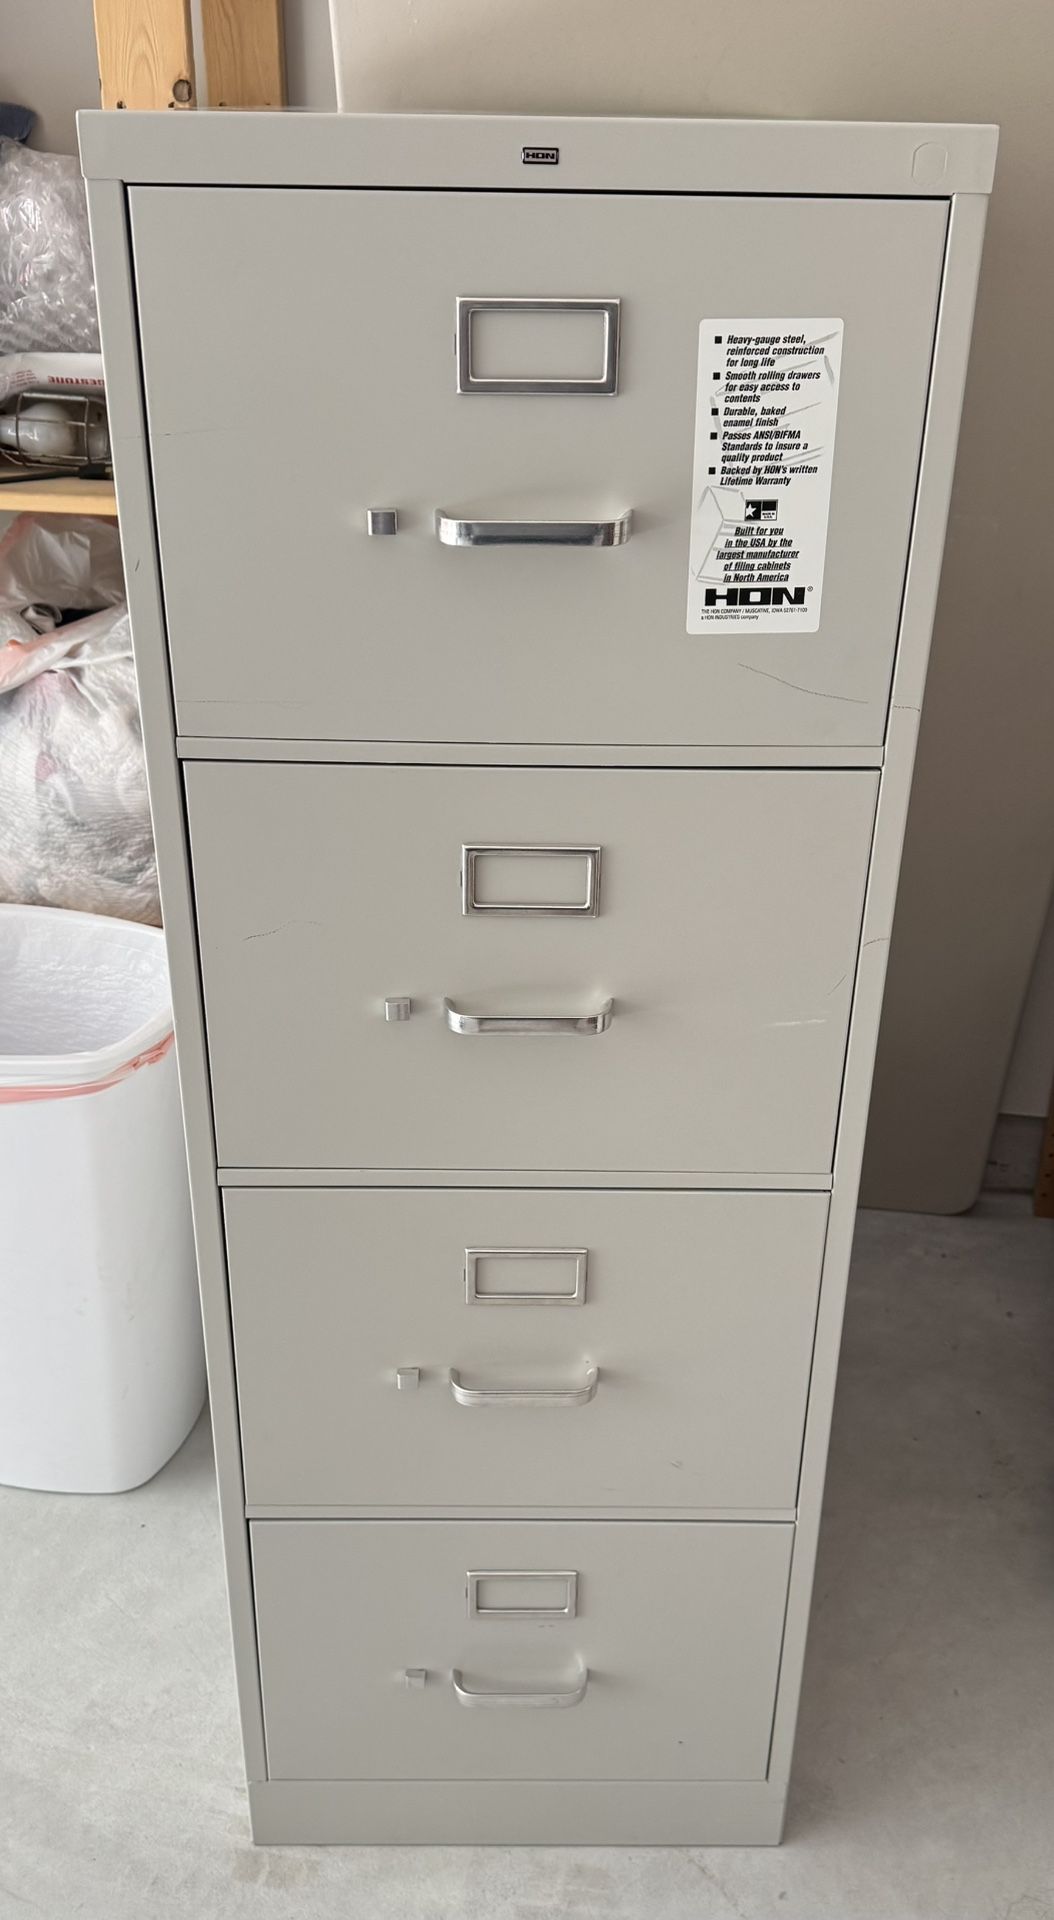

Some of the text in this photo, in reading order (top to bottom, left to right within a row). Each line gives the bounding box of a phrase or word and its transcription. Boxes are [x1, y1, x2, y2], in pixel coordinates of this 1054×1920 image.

[525, 152, 555, 160] HON
[727, 334, 806, 345] Heavy-gauge steel,
[726, 346, 825, 355] reinforced construction
[726, 358, 775, 368] for long life
[725, 371, 821, 381] Smooth rolling drawers
[725, 384, 737, 392] for
[739, 384, 758, 393] easy
[792, 383, 800, 391] to
[724, 394, 761, 403] contents
[724, 407, 786, 416] Durable, baked
[723, 418, 778, 427] enamel finish
[722, 431, 801, 440] Passes ANSI/BIFMA
[722, 443, 762, 451] Standards
[776, 442, 801, 450] insure
[721, 453, 783, 463] quality product
[721, 466, 818, 475] Backed by HON's written
[720, 477, 791, 486] Lifetime Warranty
[735, 527, 784, 536] Built for you
[725, 538, 793, 548] in the USA by the
[716, 550, 799, 560] largest manufacturer
[723, 562, 791, 571] of filing cabinets
[723, 573, 789, 583] in North America
